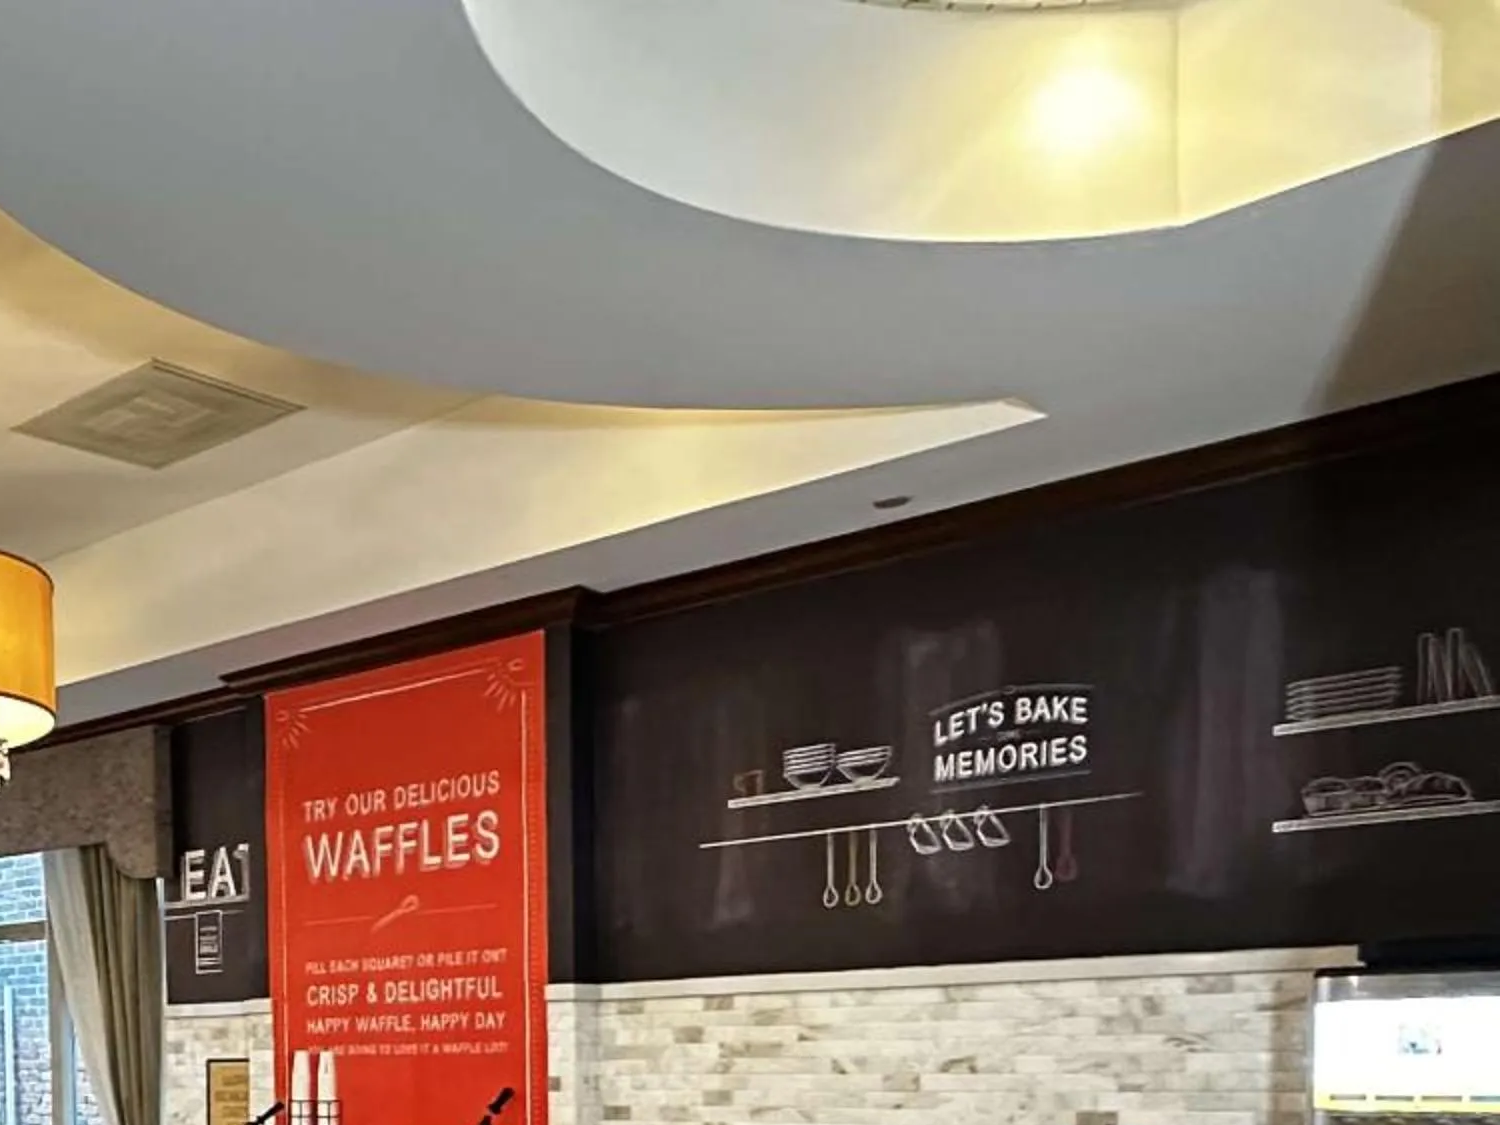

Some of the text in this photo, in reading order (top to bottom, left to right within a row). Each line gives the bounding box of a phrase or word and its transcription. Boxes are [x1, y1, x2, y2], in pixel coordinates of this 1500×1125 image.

[934, 696, 1088, 747] LET'S BAKE
[934, 735, 1087, 783] MEMORIES
[303, 769, 501, 823] TRY OUR DELICIOUS
[304, 810, 500, 884] WAFFLES
[329, 959, 359, 974] EACH
[417, 952, 434, 968] OR
[437, 950, 463, 967] PILE
[465, 949, 478, 965] IT
[307, 974, 503, 1007] CRISP & DELIGHTFUL
[307, 1016, 350, 1035] HAPPY
[420, 1012, 470, 1032] HAPPY
[474, 1010, 506, 1031] DAY
